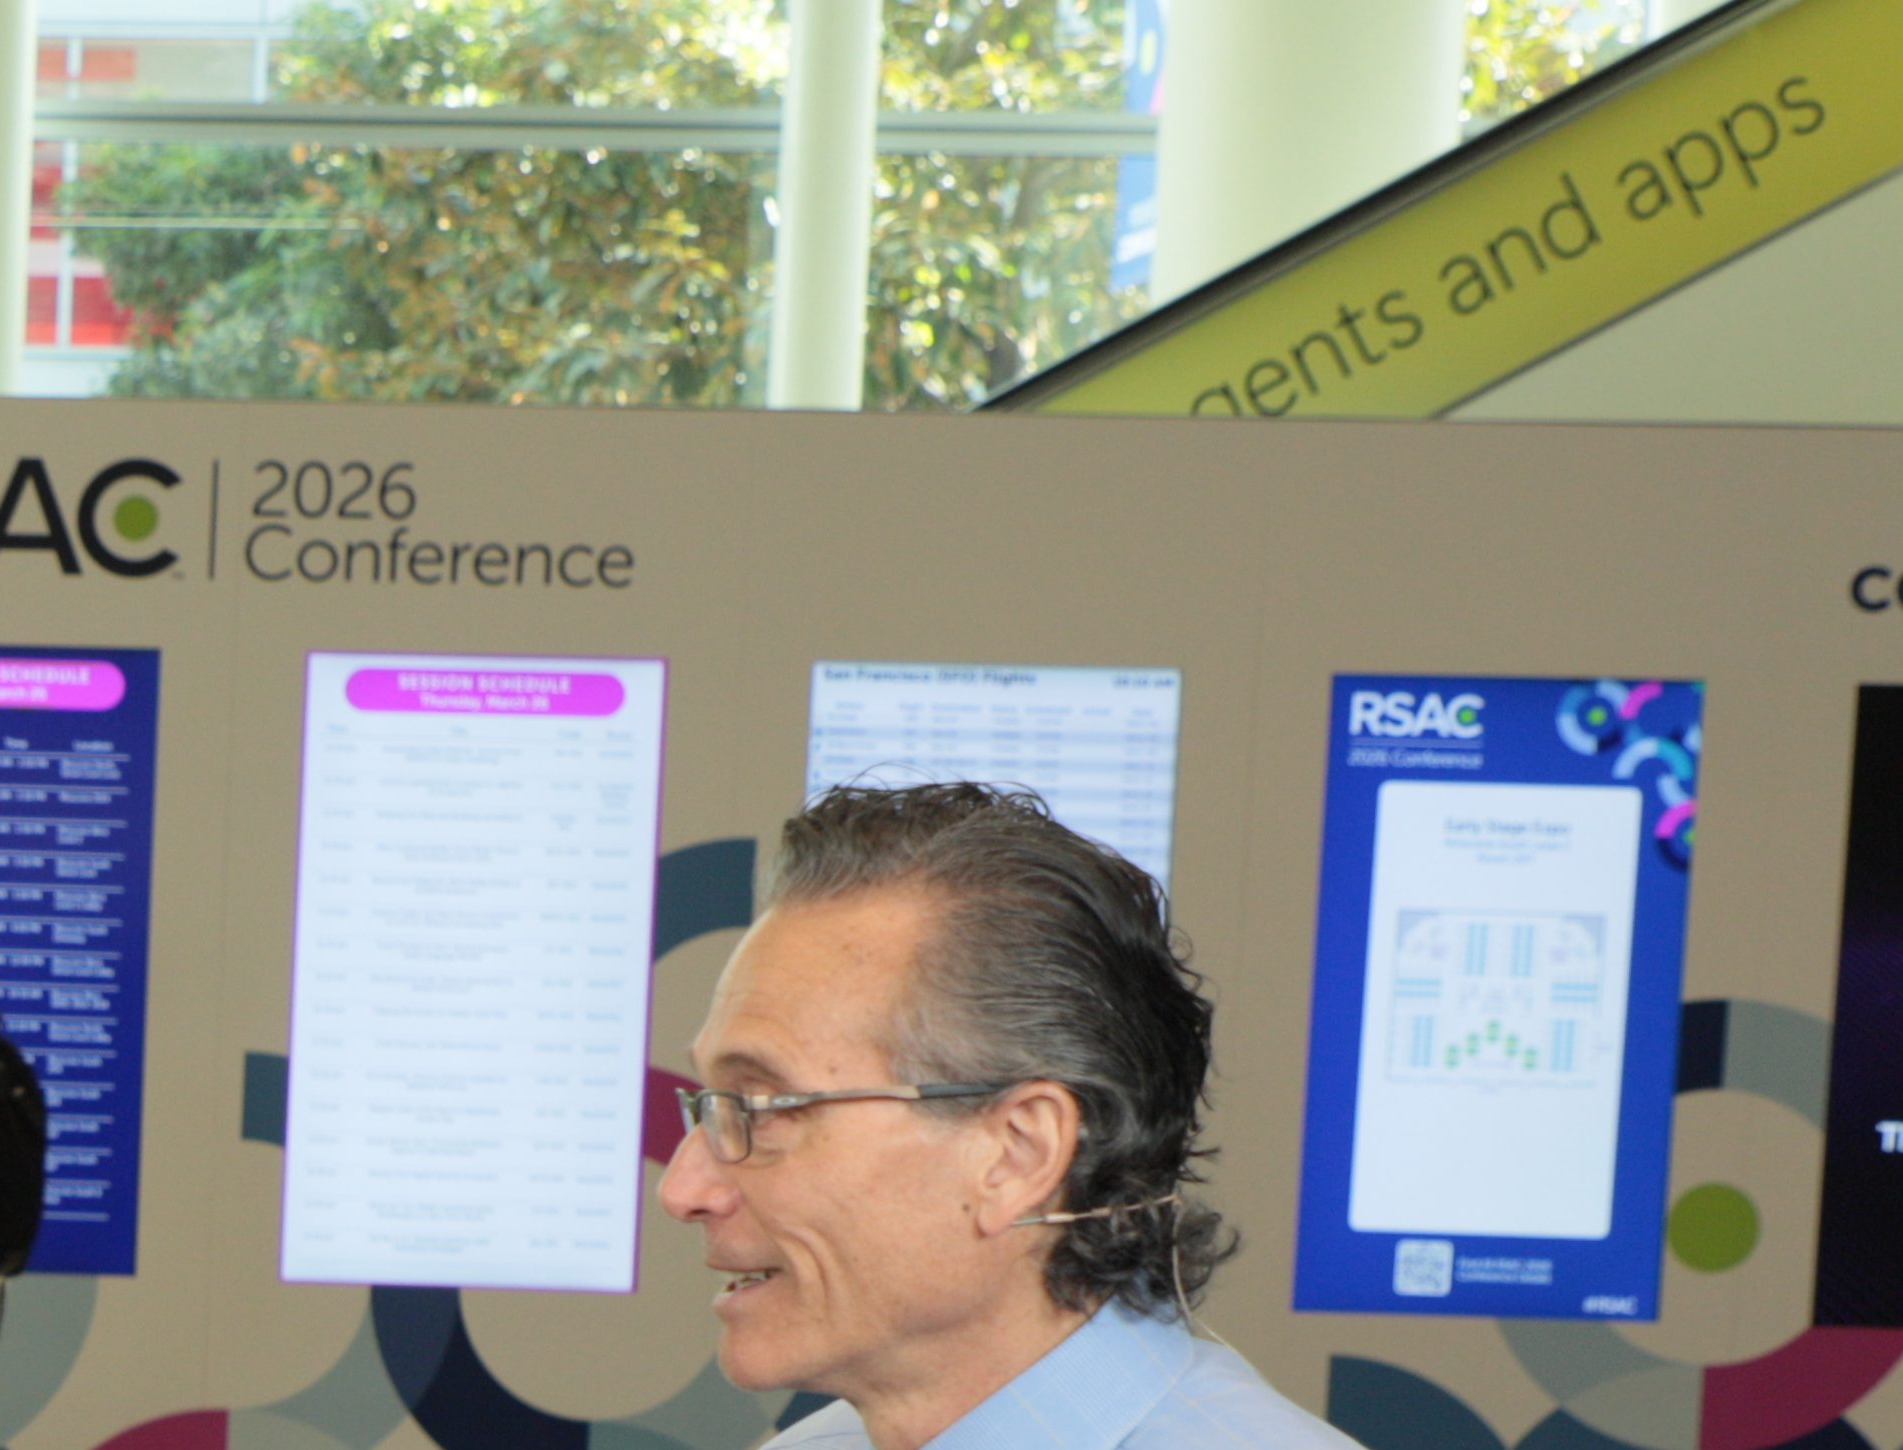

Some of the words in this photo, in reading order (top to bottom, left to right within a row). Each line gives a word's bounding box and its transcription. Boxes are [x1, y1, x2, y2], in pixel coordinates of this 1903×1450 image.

[1436, 172, 1604, 318] and
[1615, 75, 1827, 217] apps
[250, 460, 418, 520] 2026
[244, 522, 635, 589] Conference
[1851, 566, 1903, 612] C
[398, 672, 473, 691] SESSION
[479, 675, 571, 694] SCHEDULE
[1349, 689, 1484, 738] RSAC
